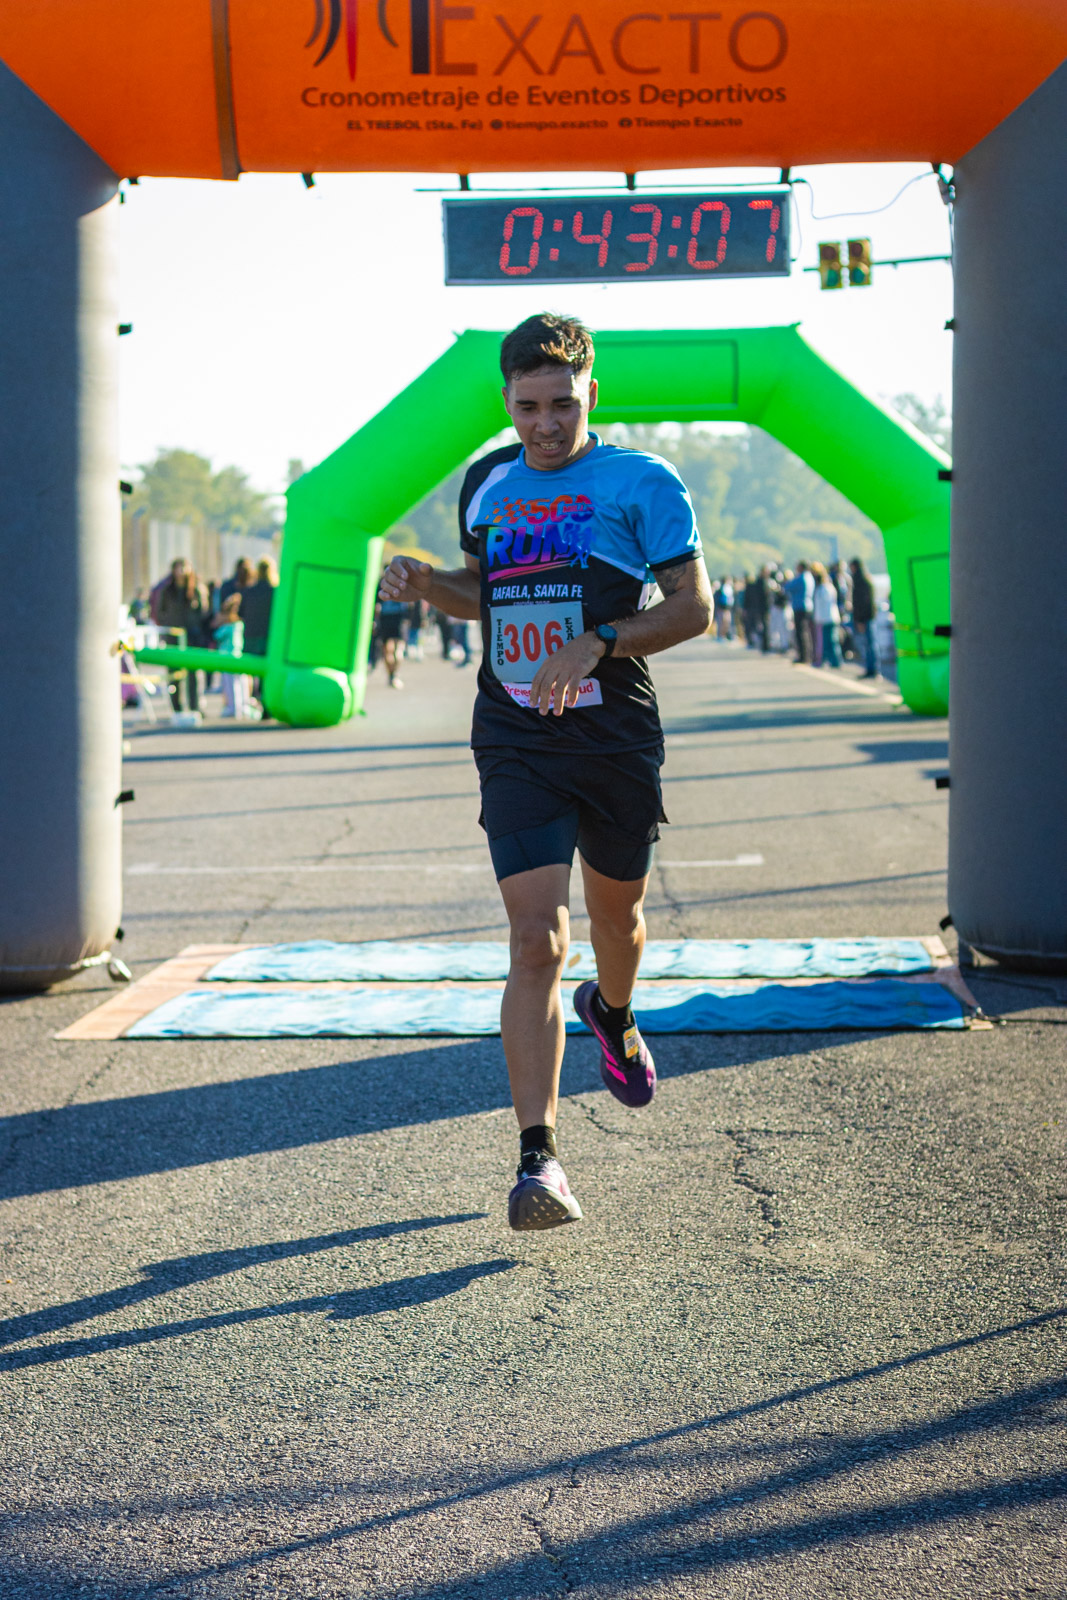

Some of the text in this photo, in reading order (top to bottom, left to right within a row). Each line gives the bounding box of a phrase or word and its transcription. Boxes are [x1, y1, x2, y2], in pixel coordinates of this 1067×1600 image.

[434, 0, 789, 77] EXACTO
[301, 83, 787, 111] Cronometraje de Eventos Deportivos
[347, 119, 363, 130] EL
[460, 119, 483, 131] Fe)
[635, 117, 692, 130] Tiempo
[694, 116, 743, 128] Exacto
[499, 199, 781, 275] 0:43:07
[492, 584, 583, 600] RAFAELA, SANTA FE
[496, 618, 505, 666] TIEMPO
[503, 620, 565, 663] 306
